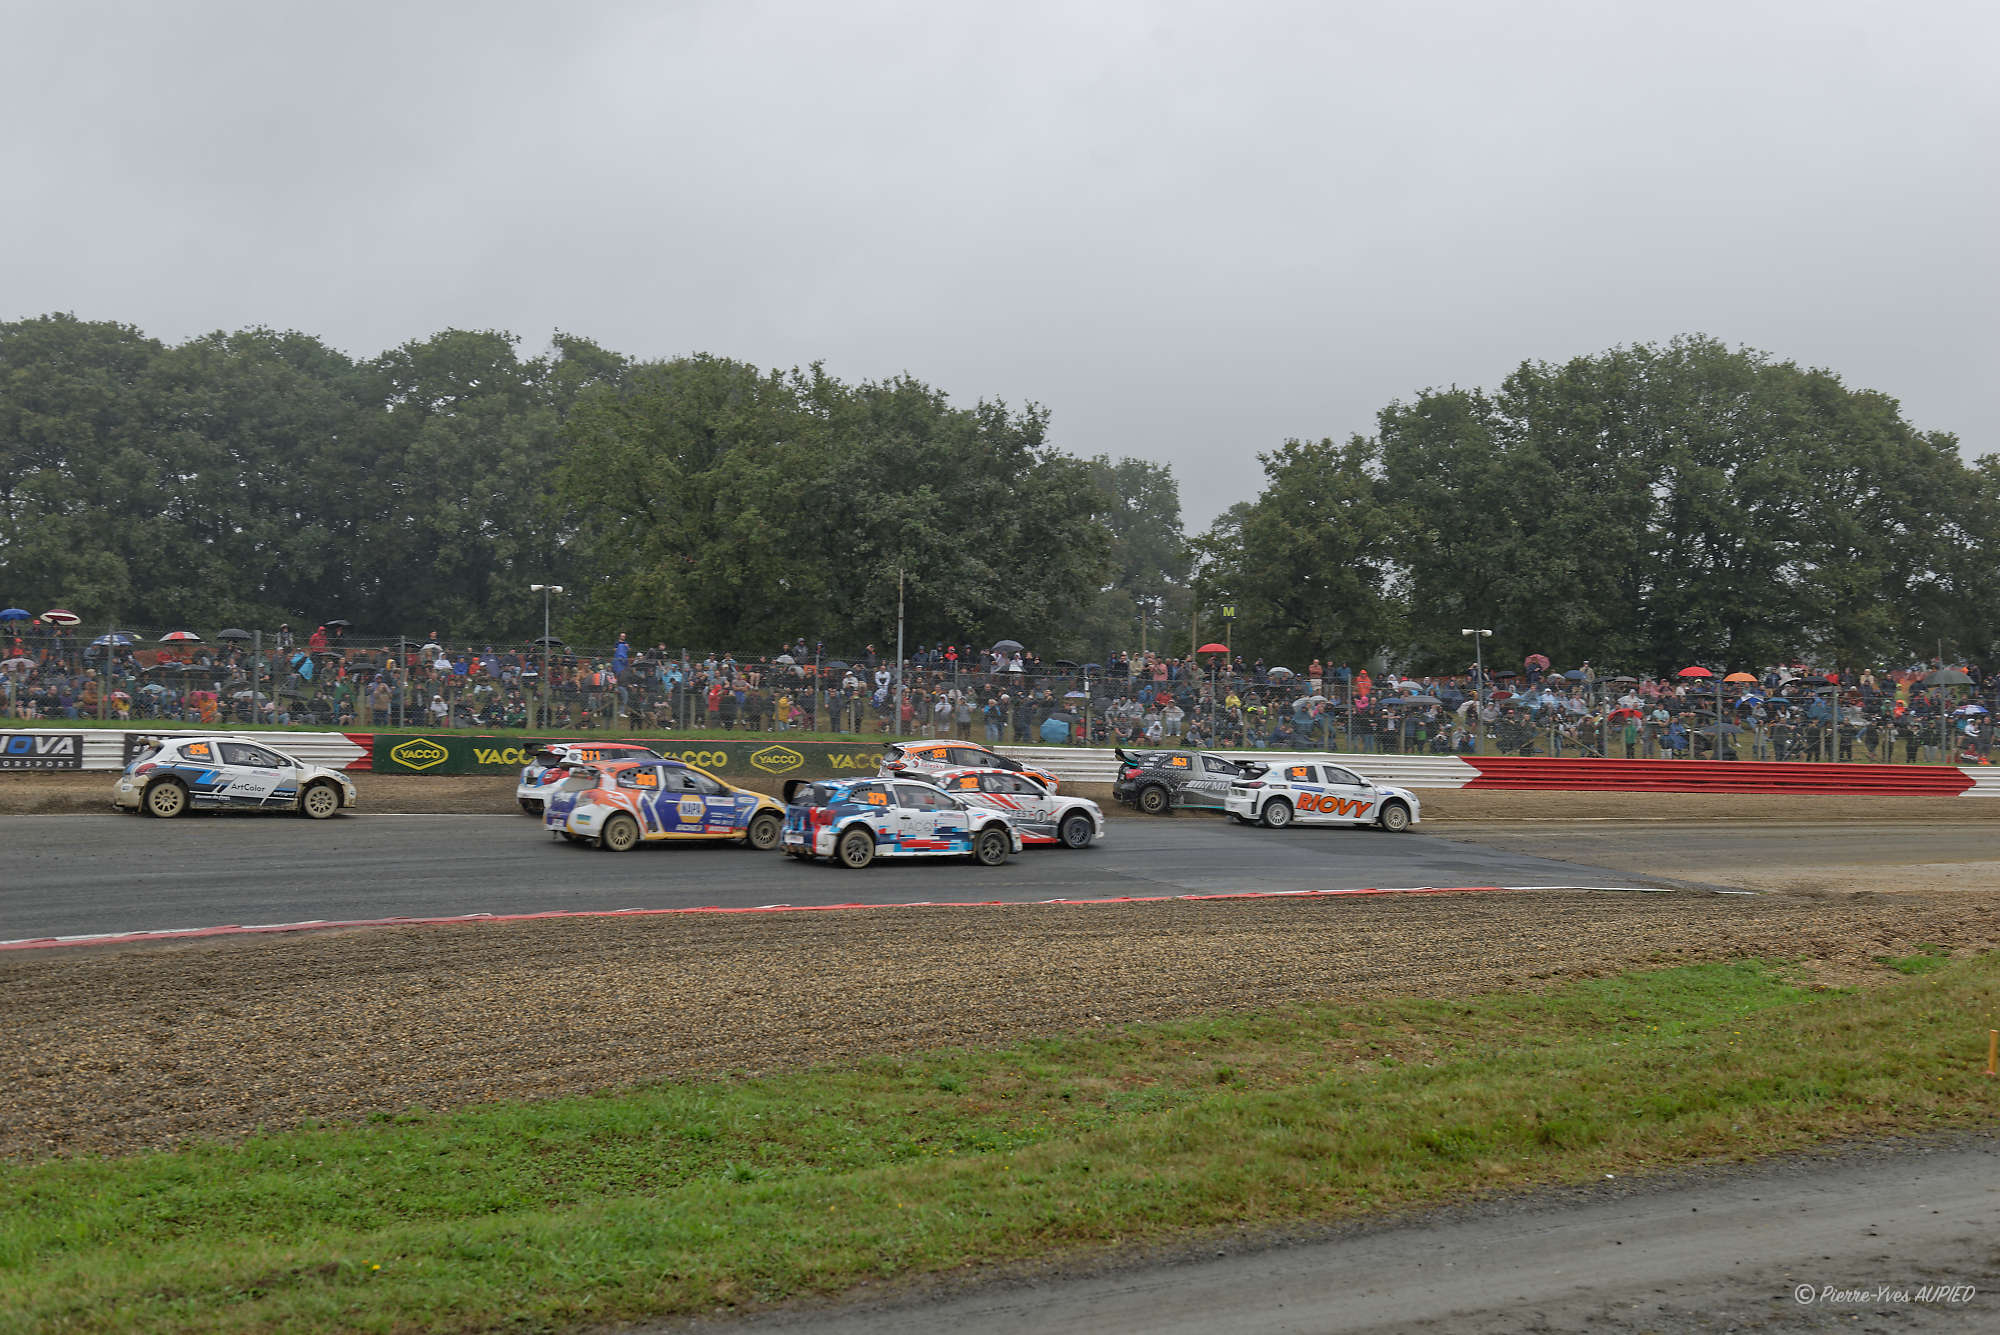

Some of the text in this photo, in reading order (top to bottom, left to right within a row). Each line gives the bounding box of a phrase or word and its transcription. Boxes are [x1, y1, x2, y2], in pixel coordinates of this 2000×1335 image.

[1223, 606, 1235, 617] M
[400, 749, 441, 760] YACCO
[759, 755, 796, 765] YACCO
[231, 783, 266, 793] ArtColor
[1296, 792, 1374, 818] RIOVY
